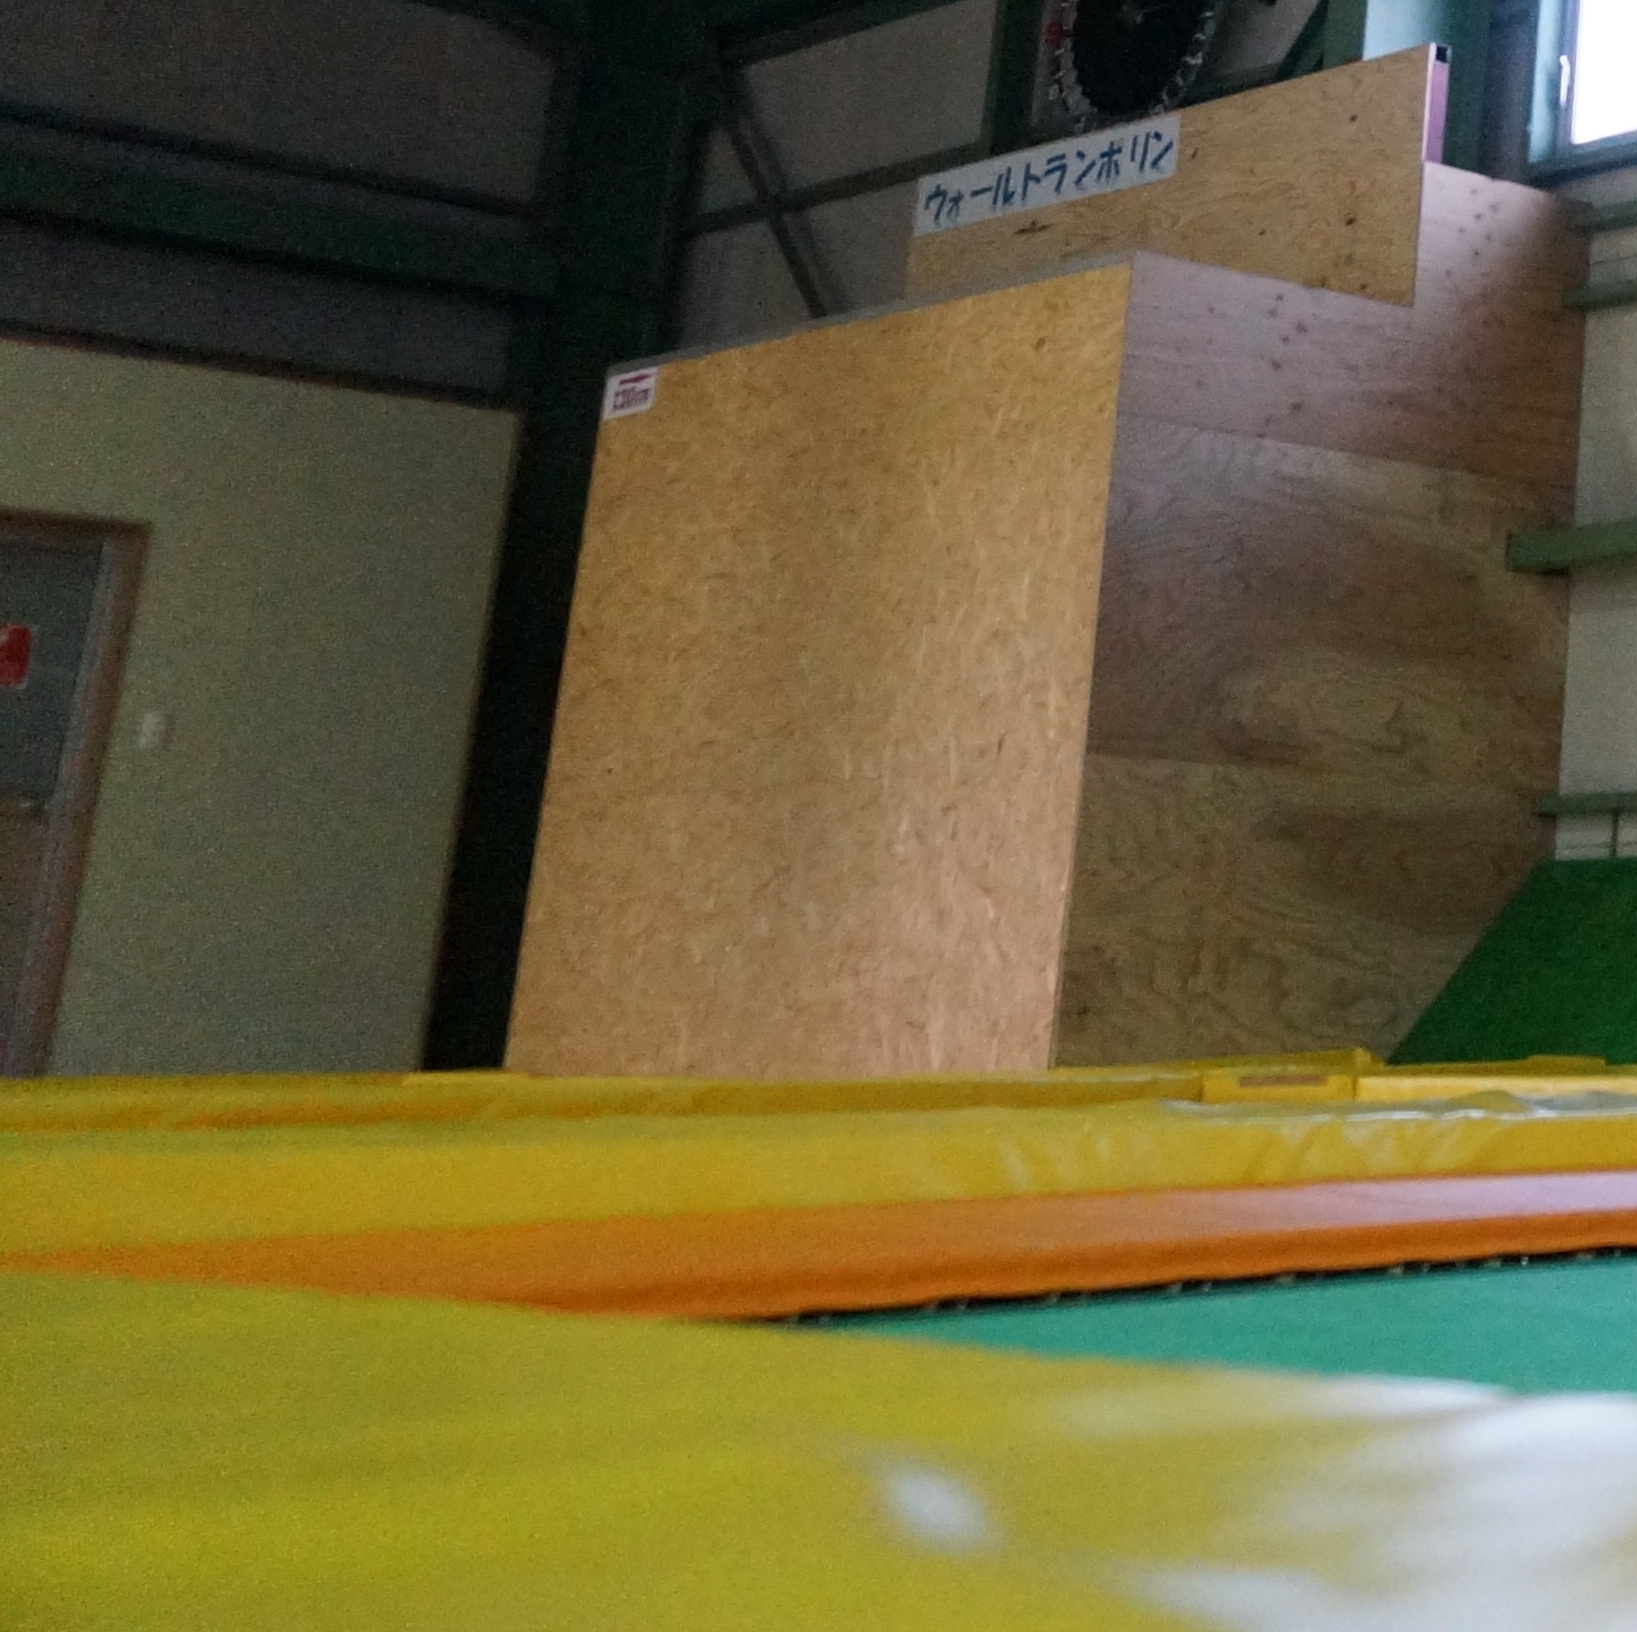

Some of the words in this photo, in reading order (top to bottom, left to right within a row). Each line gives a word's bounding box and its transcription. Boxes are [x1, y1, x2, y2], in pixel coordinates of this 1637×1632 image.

[924, 130, 1174, 220] ウォールトランポリン
